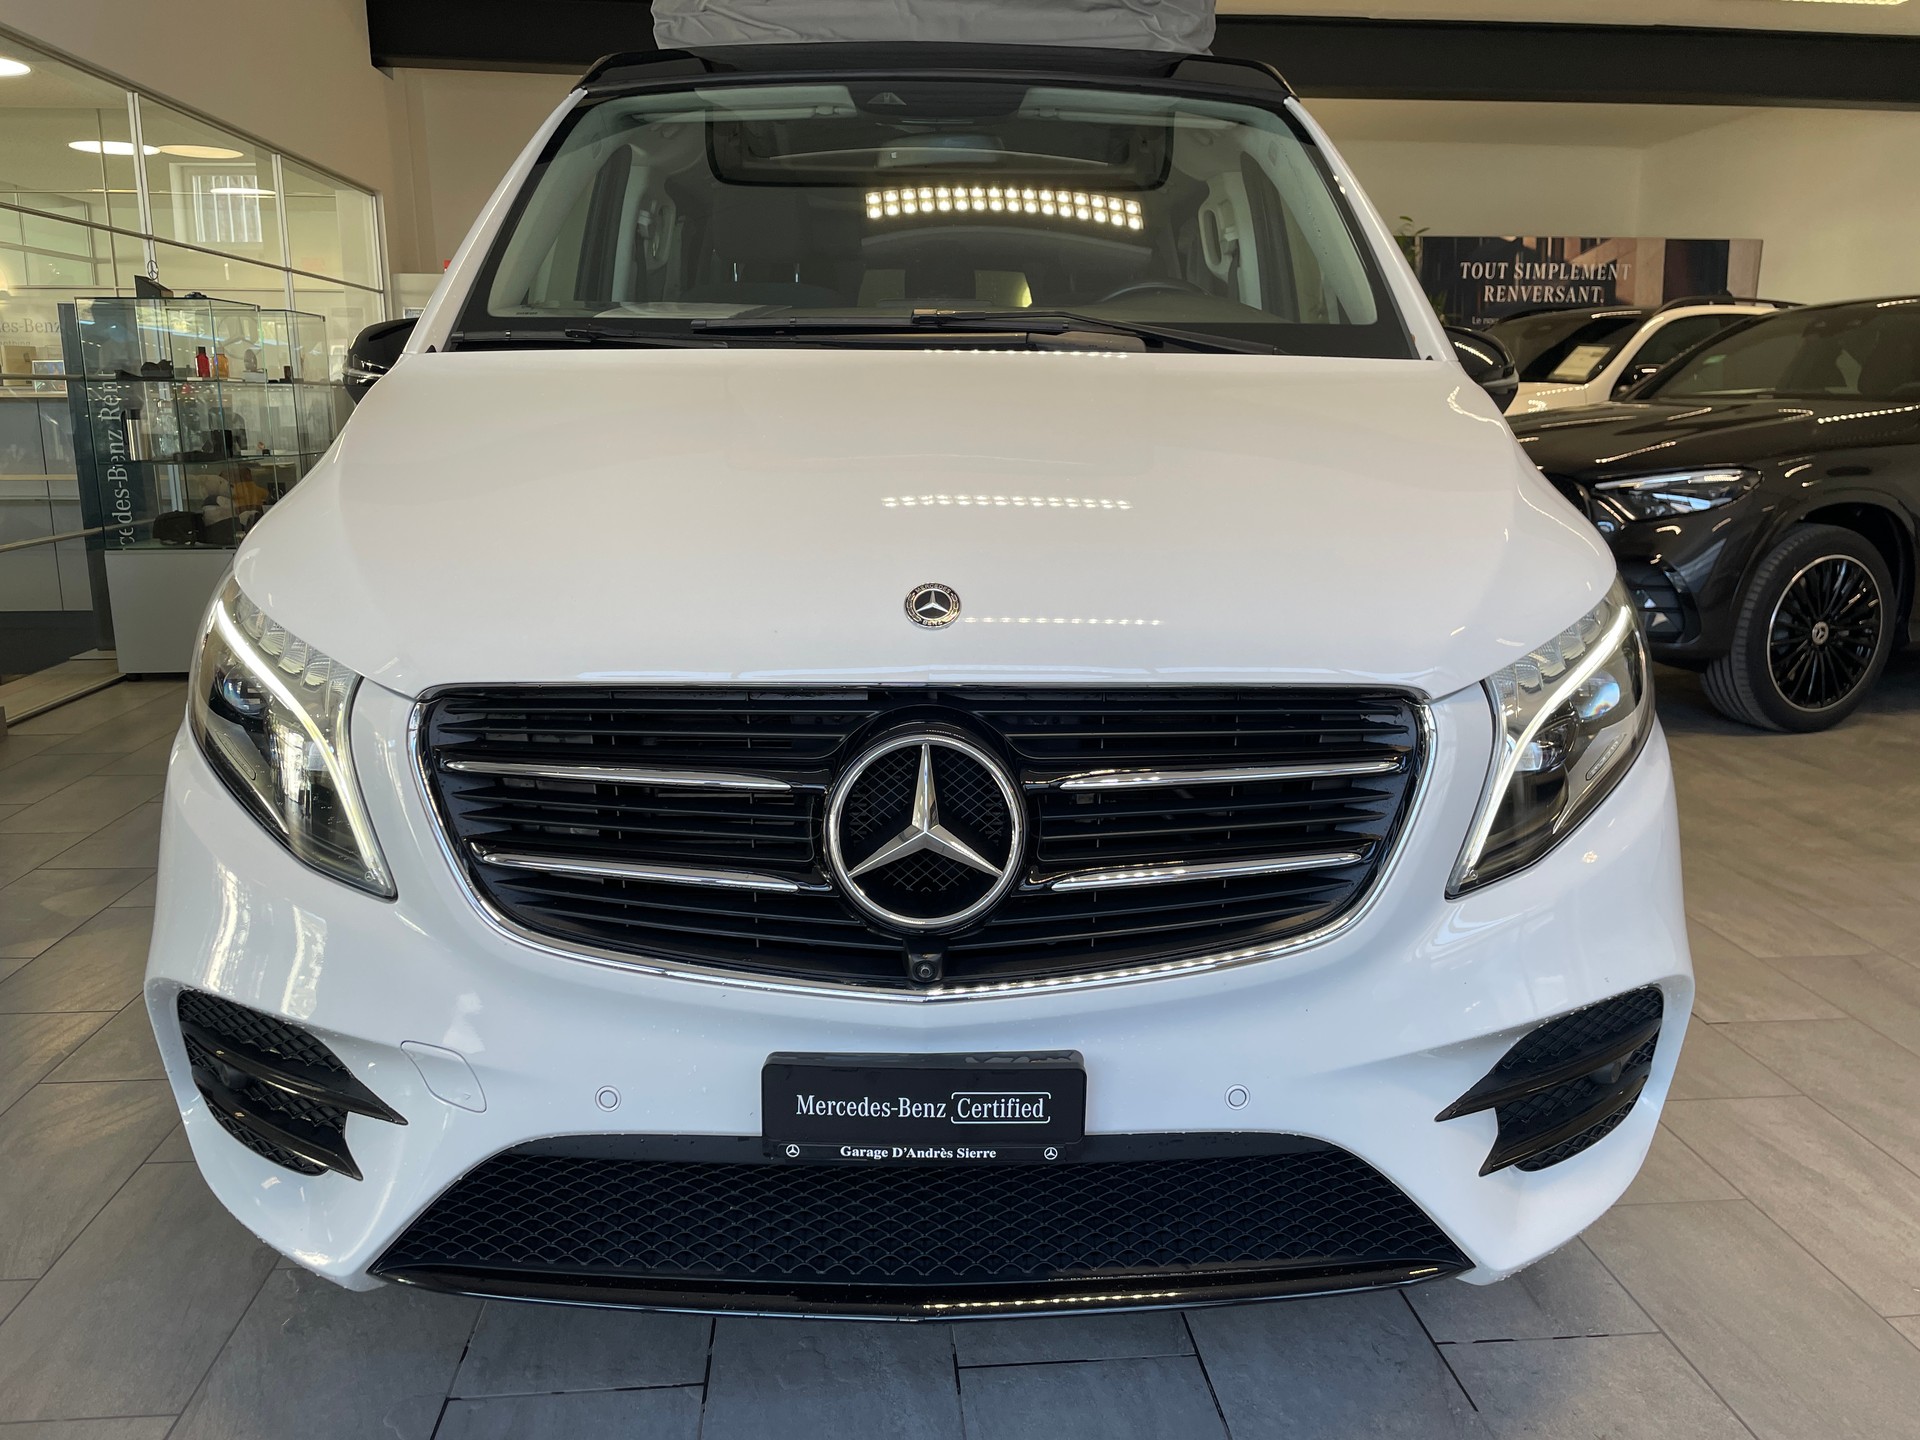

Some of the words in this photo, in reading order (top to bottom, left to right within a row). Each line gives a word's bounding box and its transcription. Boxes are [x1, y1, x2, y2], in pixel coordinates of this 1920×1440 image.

[1460, 262, 1508, 280] TOUT
[1513, 262, 1632, 281] SIMPLEMENT
[1484, 284, 1604, 304] RENVERSANT.
[0, 317, 60, 333] es-Benz
[97, 371, 122, 421] Rent
[107, 430, 135, 551] cedes-Benz
[795, 1094, 947, 1119] Mercedes-Benz
[957, 1098, 1044, 1119] Certified
[840, 1145, 889, 1160] Garage
[892, 1147, 953, 1160] D'Andrès
[956, 1147, 997, 1160] Sierre
